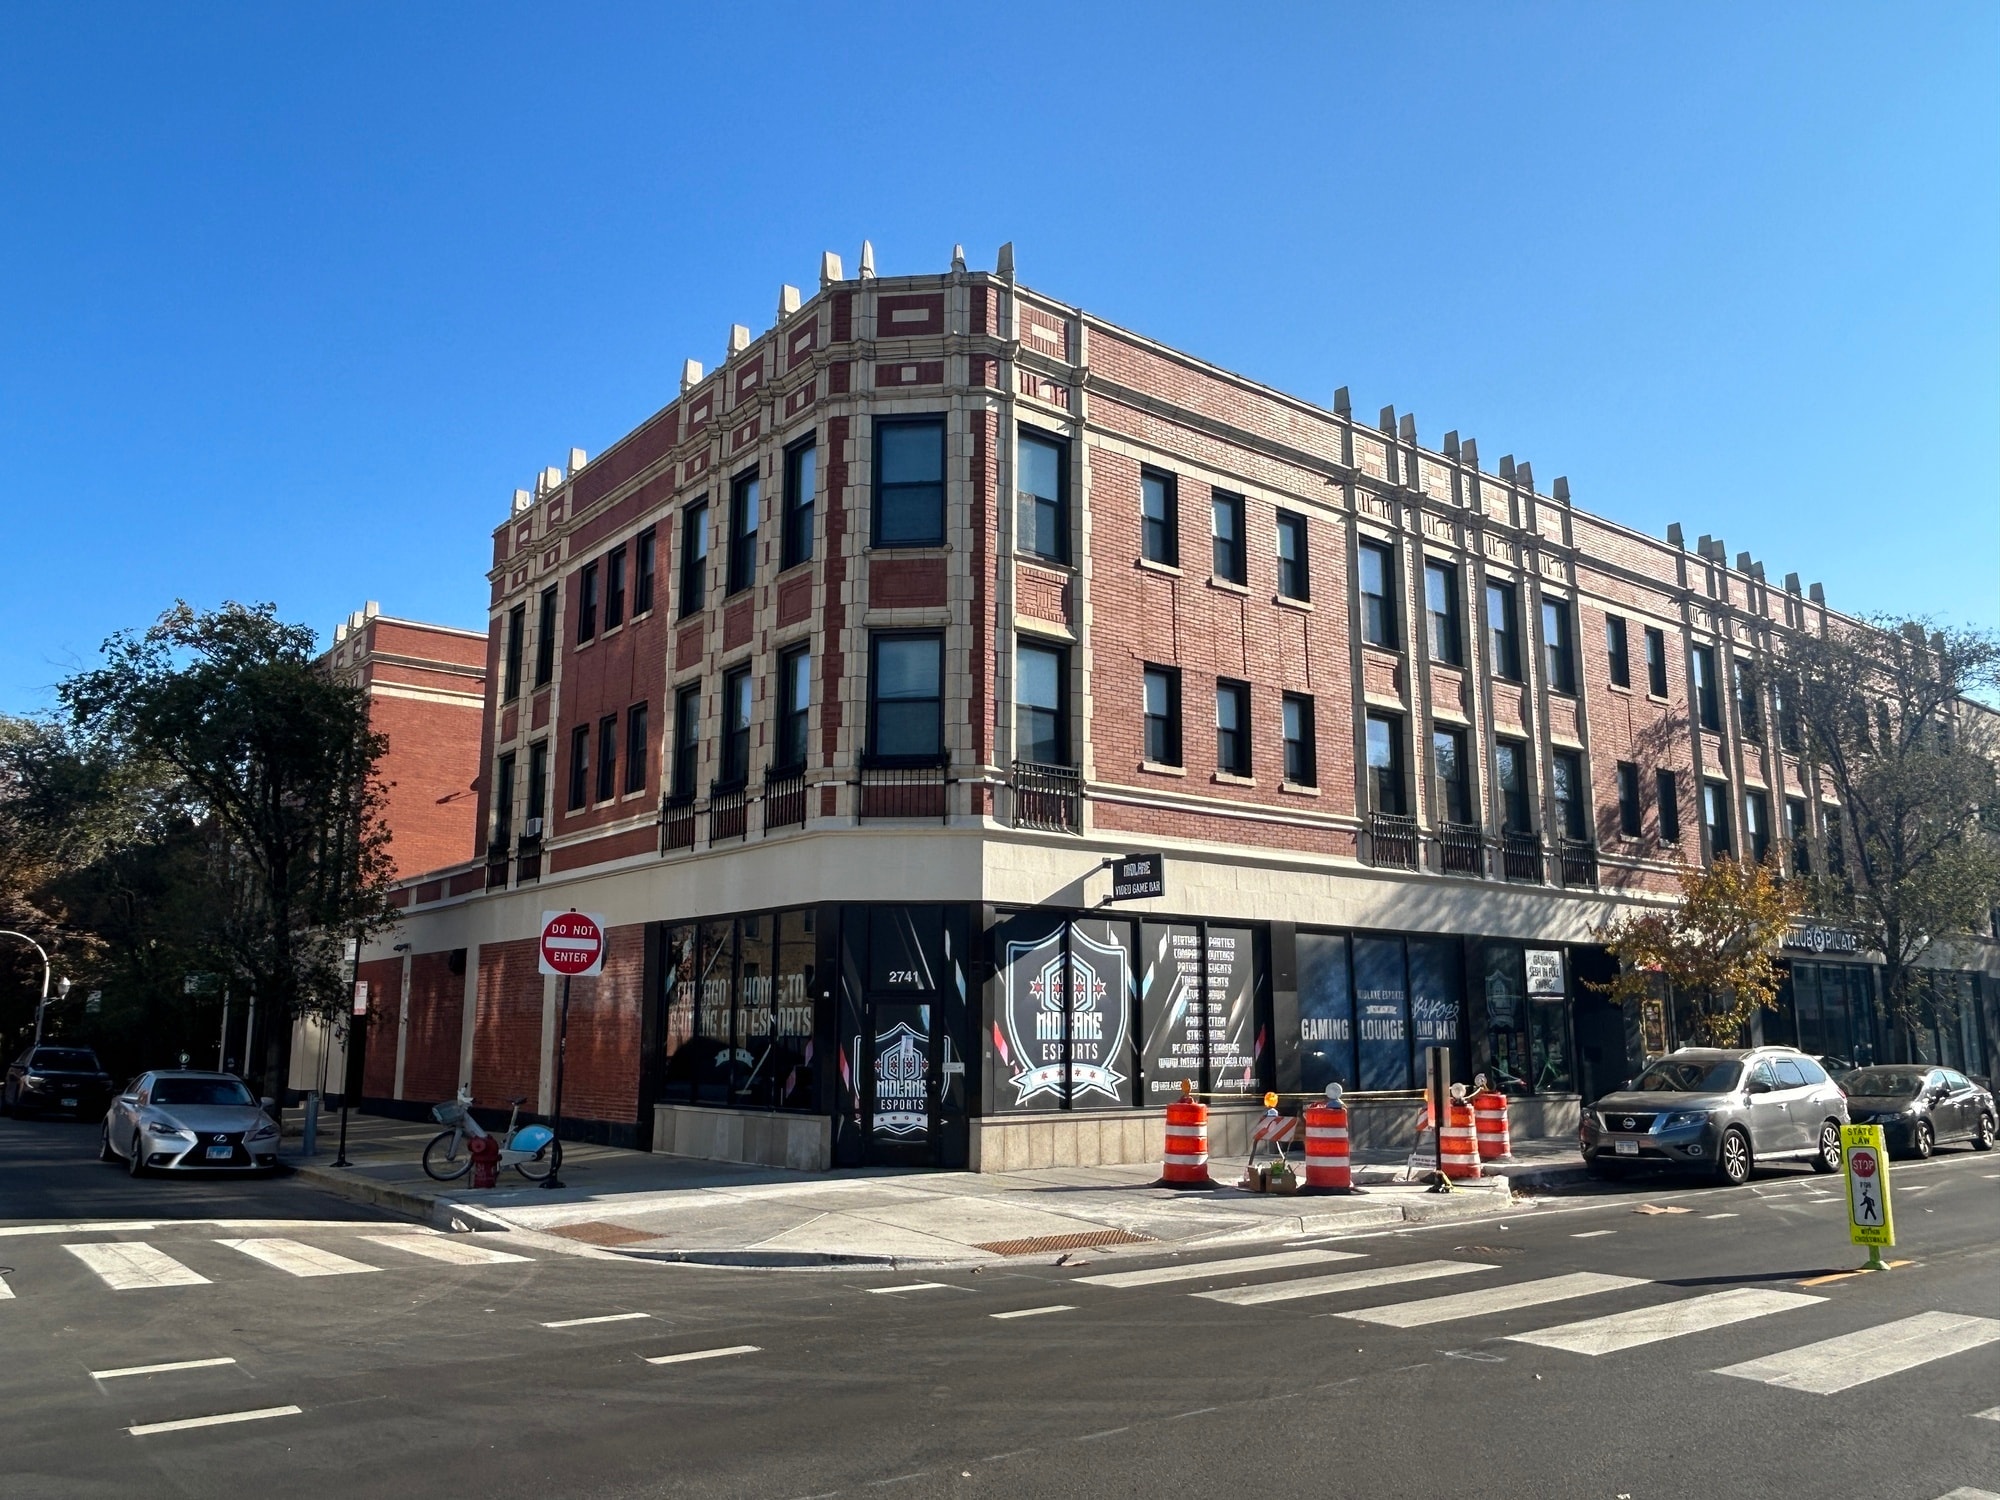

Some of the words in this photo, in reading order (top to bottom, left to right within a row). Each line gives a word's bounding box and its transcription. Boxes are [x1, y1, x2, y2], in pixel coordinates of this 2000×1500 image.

[1132, 882, 1148, 894] GAME
[1149, 881, 1160, 892] BAR
[552, 924, 567, 934] DO
[573, 925, 594, 936] NOT
[1786, 926, 1813, 948] CLUB
[553, 951, 588, 963] ENTER
[1207, 963, 1232, 975] EVENTS
[889, 971, 918, 983] 2741
[787, 973, 804, 1004] TO
[1301, 1018, 1349, 1040] GAMING
[1361, 1020, 1404, 1040] LOUNGE
[1416, 1020, 1433, 1036] AND
[1436, 1020, 1457, 1040] BAR
[881, 1099, 924, 1110] ESPORTS
[1847, 1128, 1873, 1136] STATE
[1852, 1137, 1870, 1145] LAW
[1853, 1160, 1874, 1170] STOP
